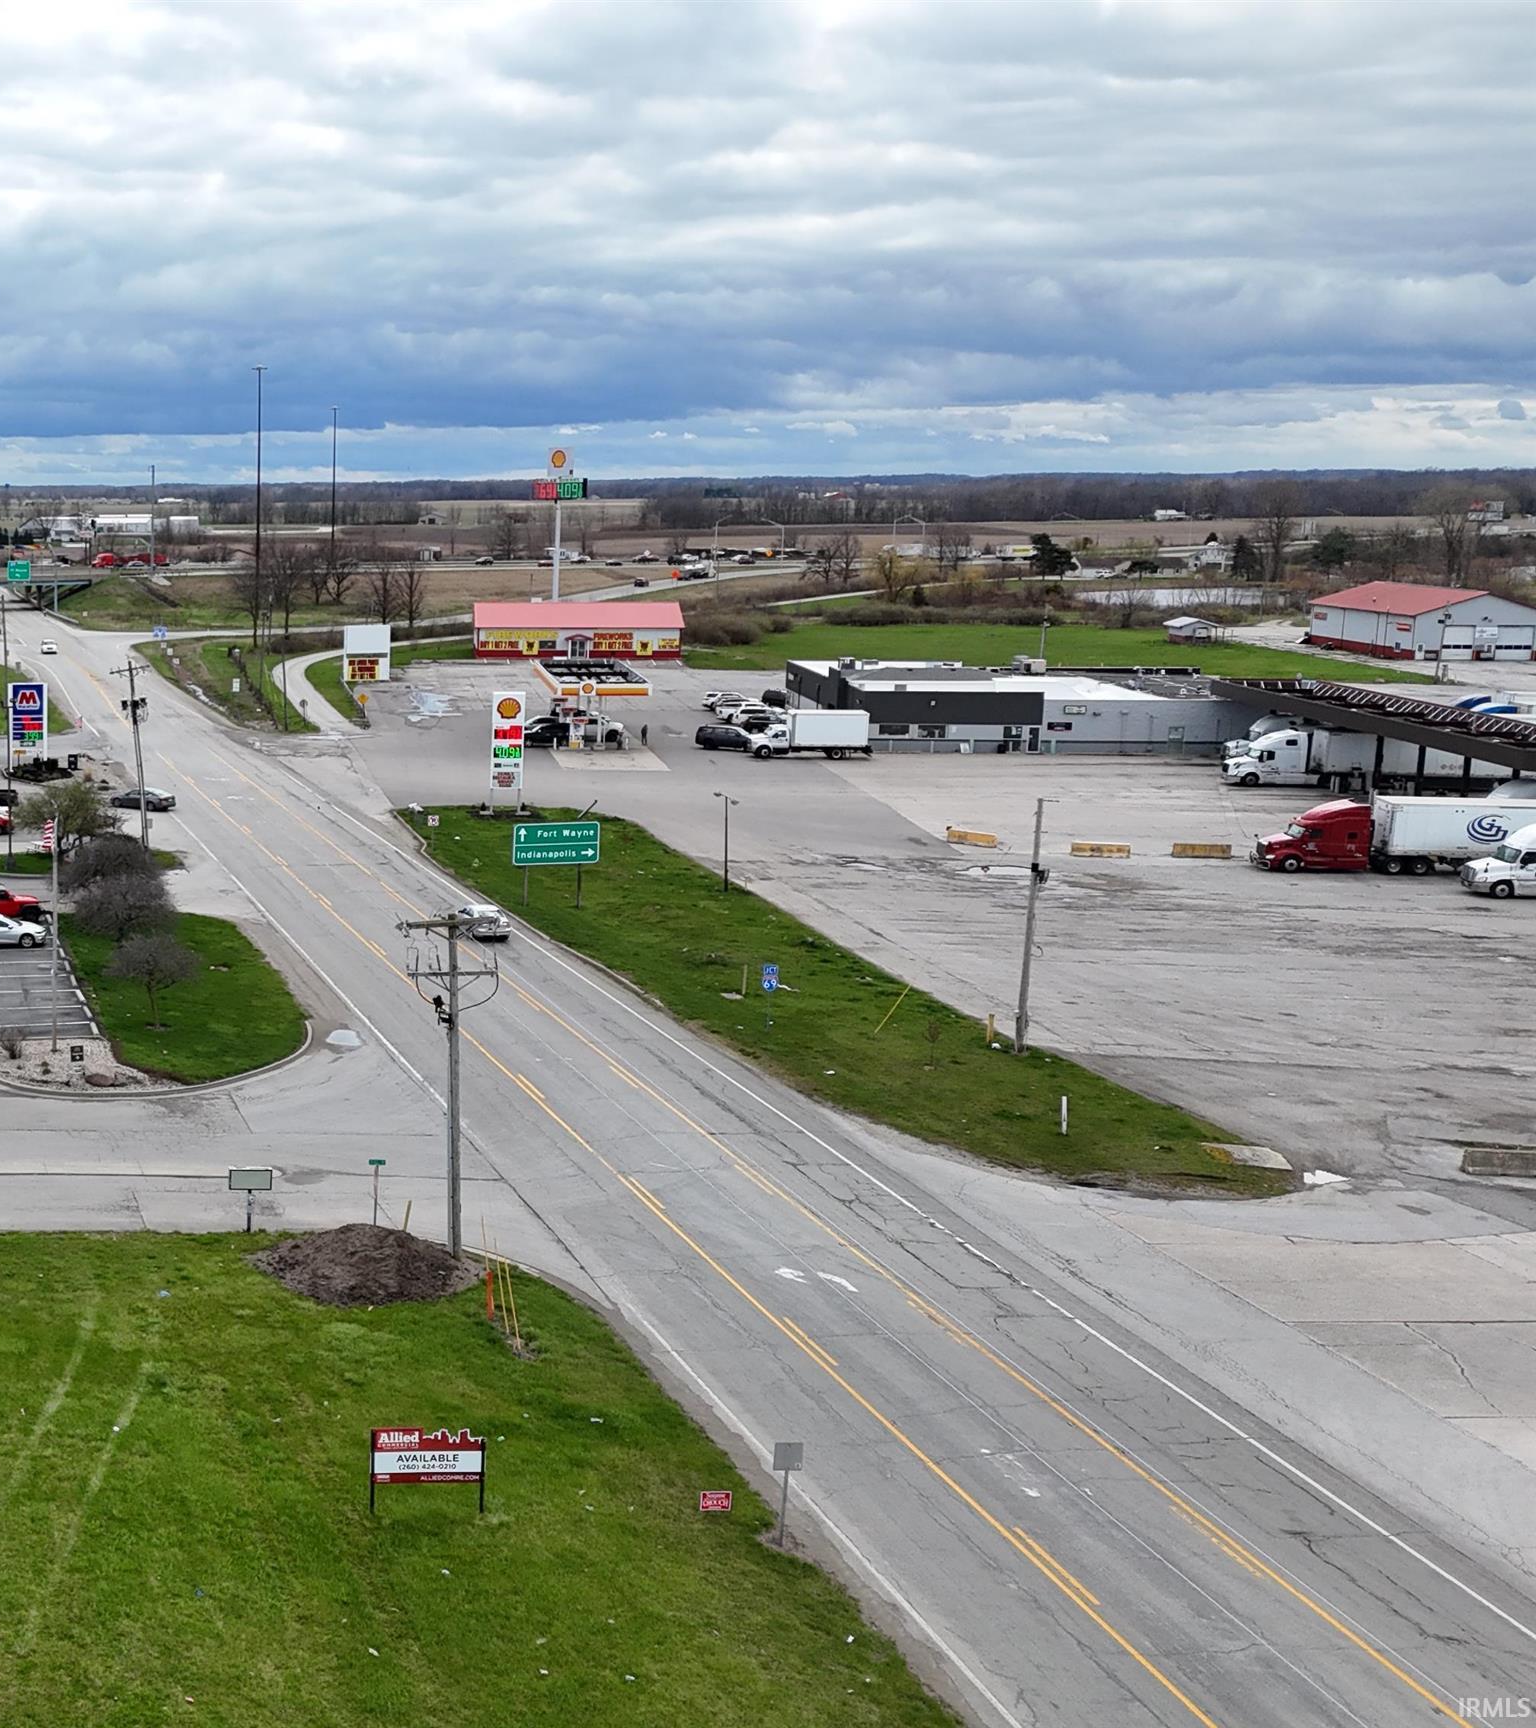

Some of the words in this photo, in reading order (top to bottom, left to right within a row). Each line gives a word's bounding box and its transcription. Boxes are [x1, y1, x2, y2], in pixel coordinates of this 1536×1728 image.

[593, 632, 634, 640] FIREWORKS
[537, 829, 557, 838] Fort
[562, 829, 595, 839] Wayne
[517, 850, 577, 859] Indianapolis
[765, 966, 777, 974] JCT
[764, 979, 777, 989] 69
[378, 1431, 420, 1443] Allied
[396, 1453, 460, 1463] AVAILABLE
[398, 1463, 420, 1471] (260)
